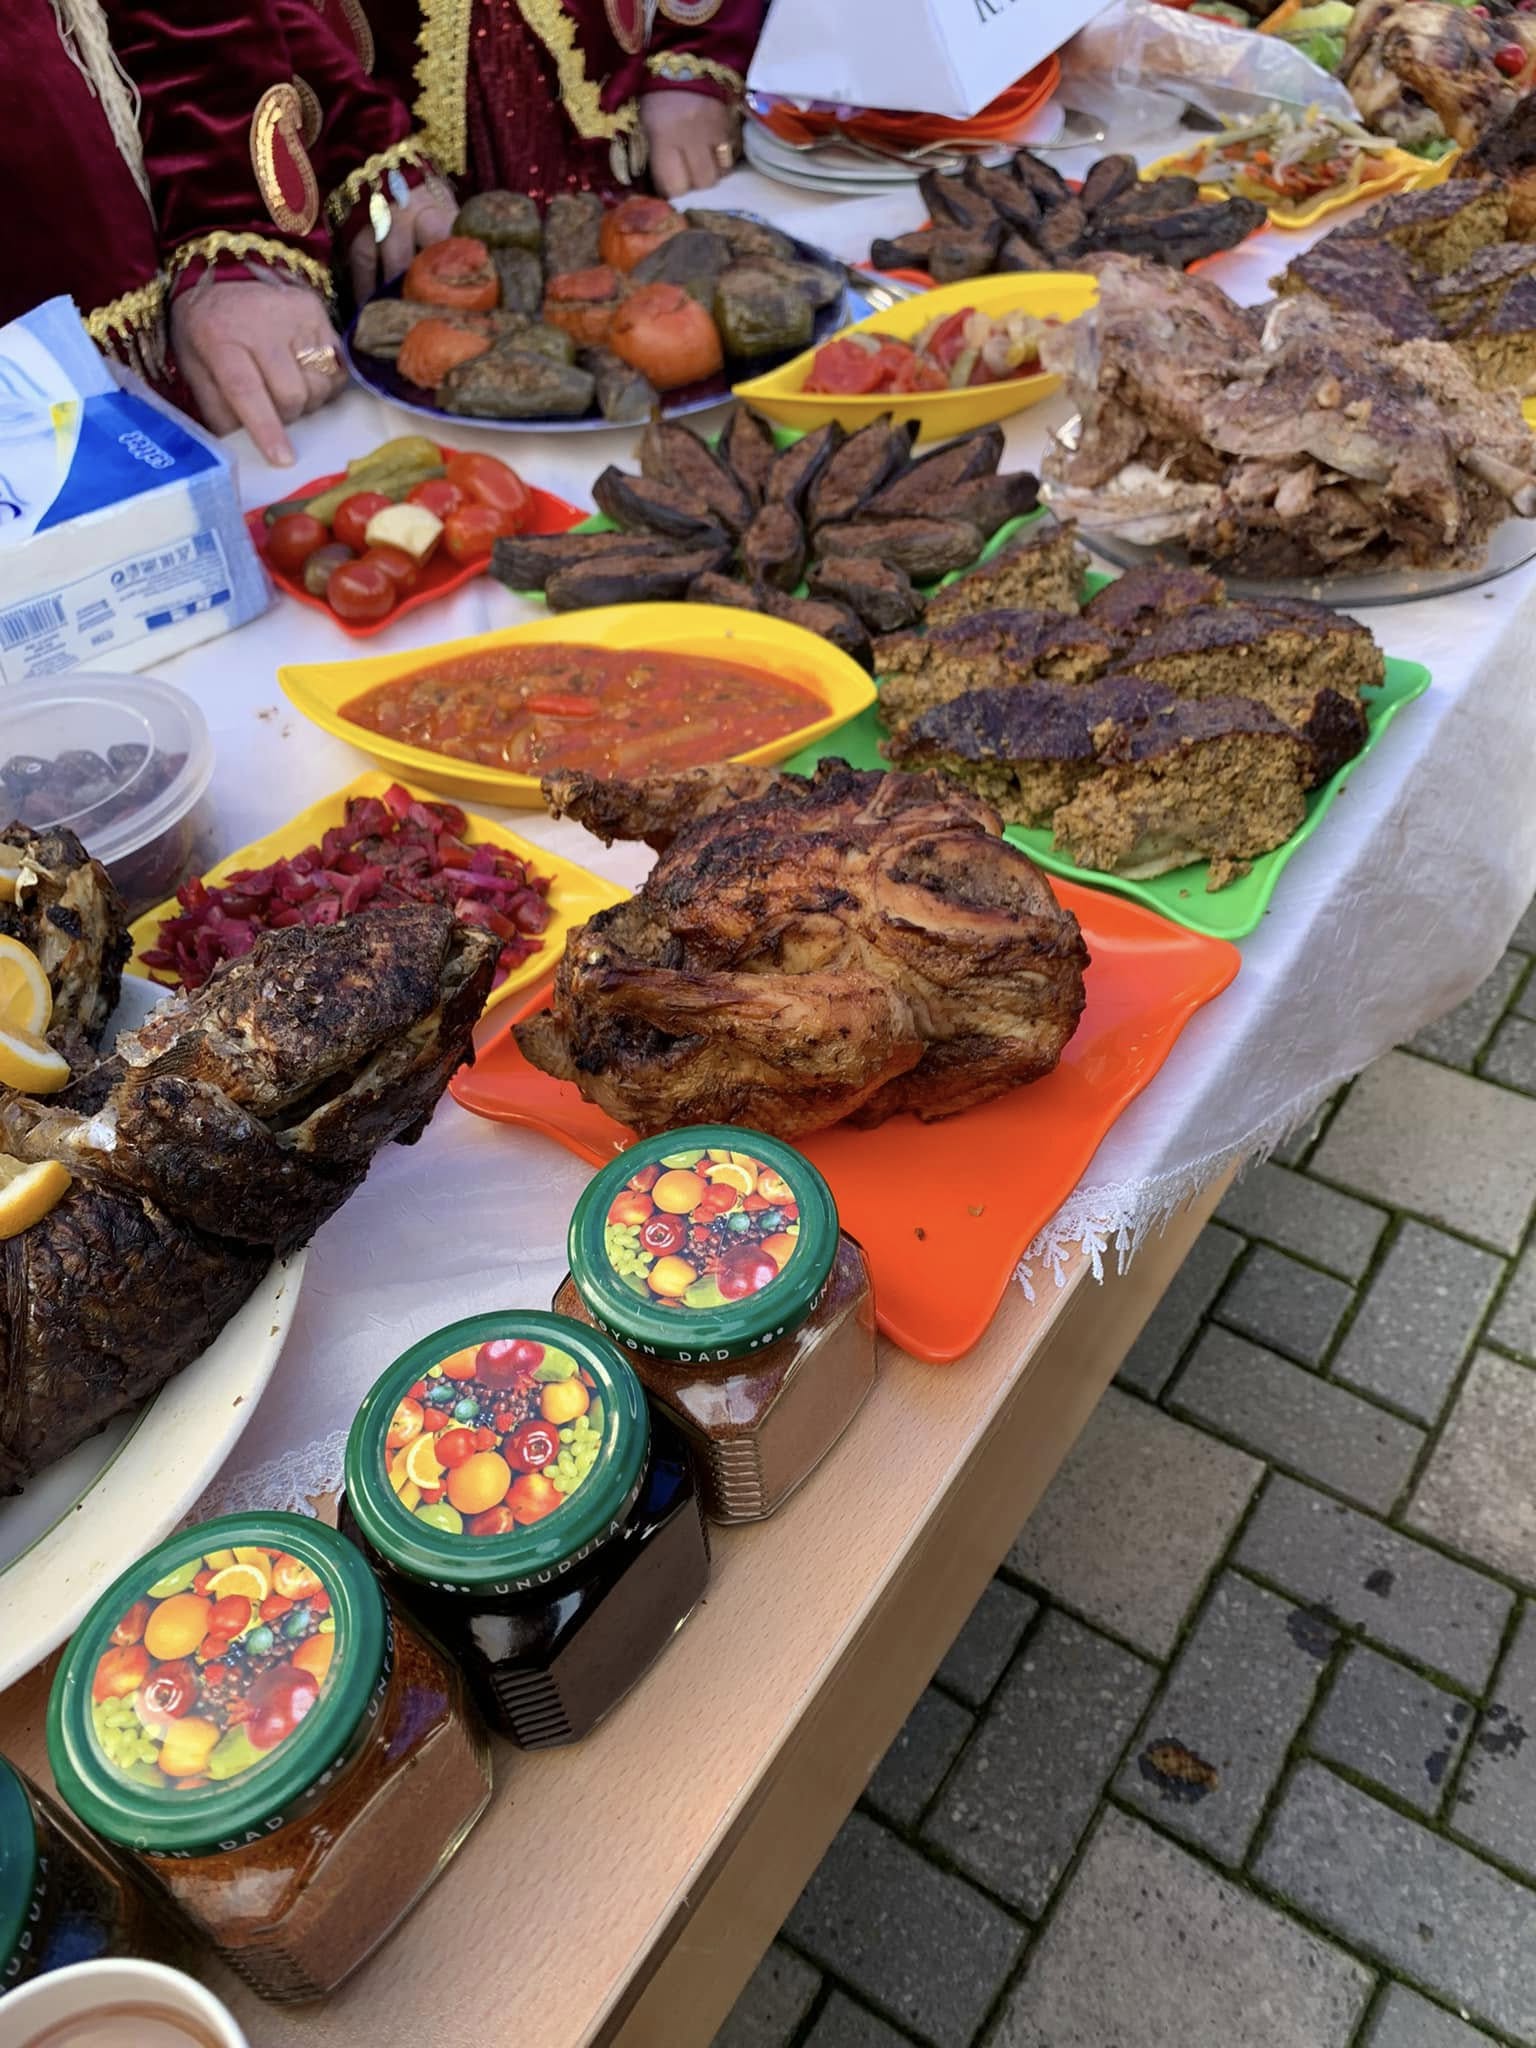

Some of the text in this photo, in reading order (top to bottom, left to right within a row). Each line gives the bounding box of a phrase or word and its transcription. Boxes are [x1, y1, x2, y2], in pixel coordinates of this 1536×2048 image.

[679, 1349, 729, 1363] DAD
[494, 1520, 620, 1595] UNUDULA
[218, 1816, 285, 1851] DAD
